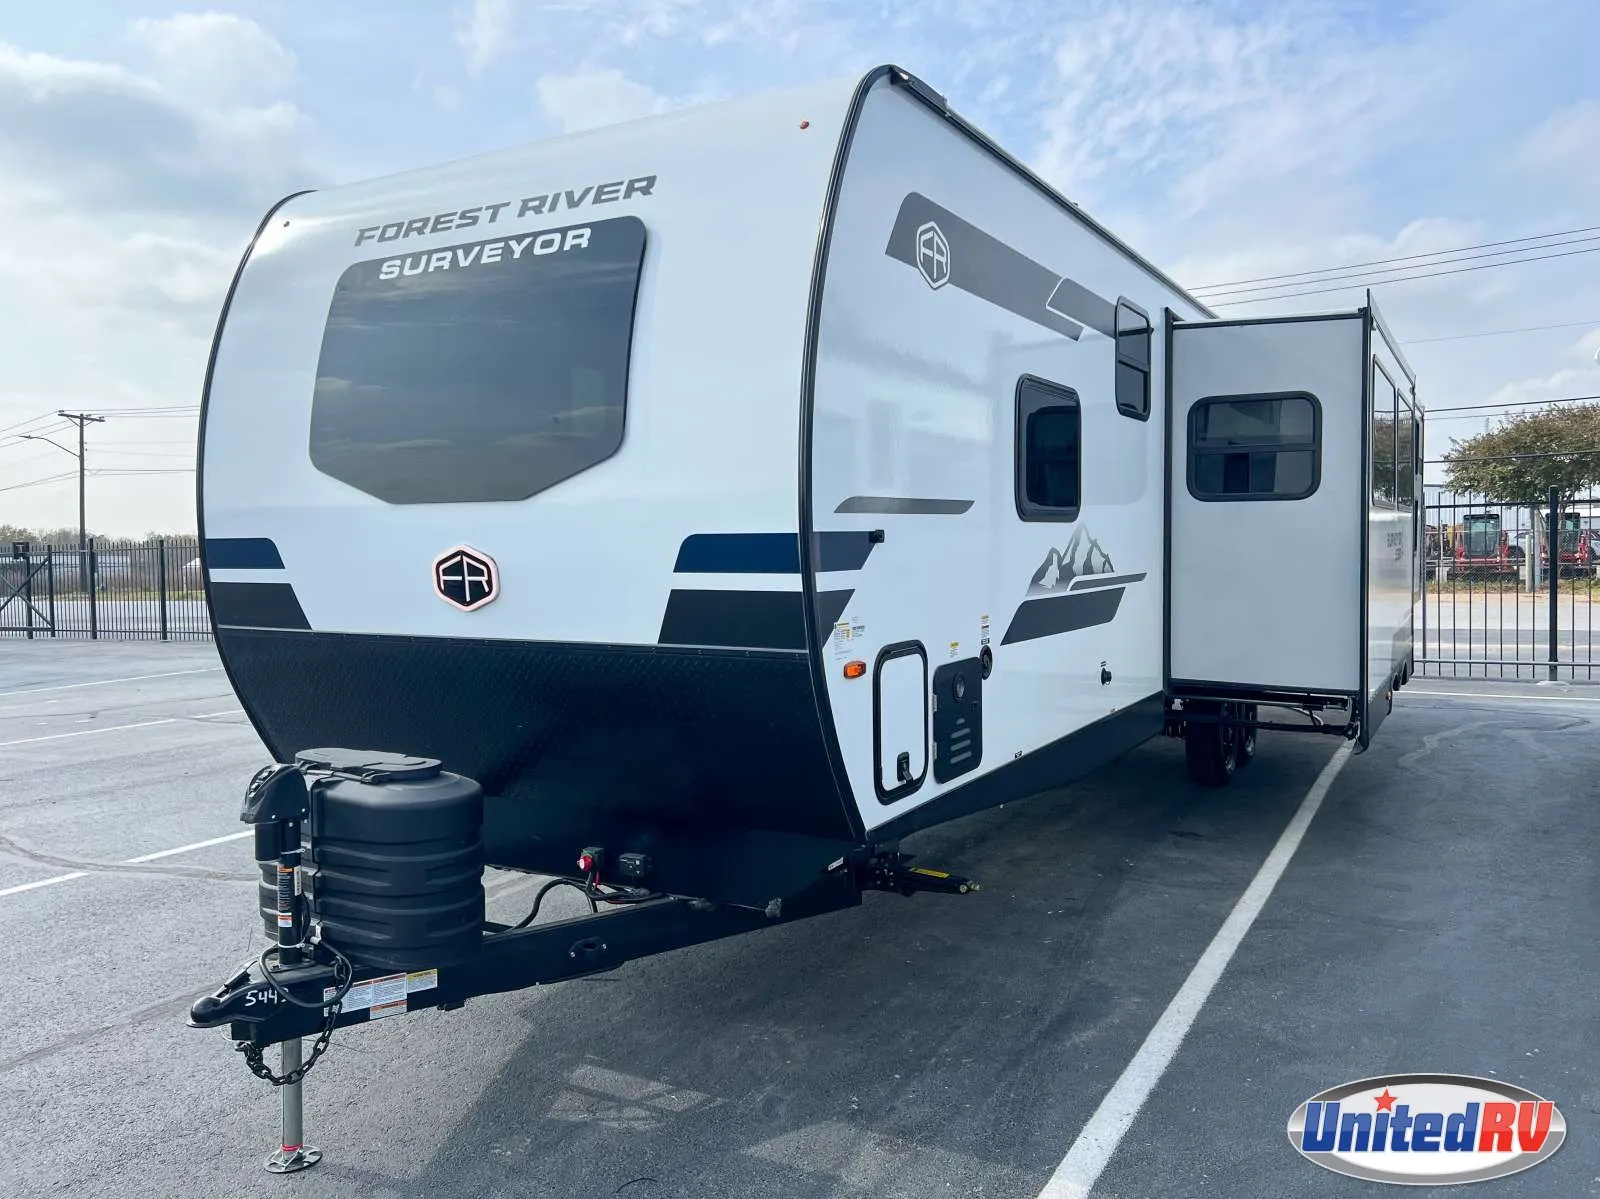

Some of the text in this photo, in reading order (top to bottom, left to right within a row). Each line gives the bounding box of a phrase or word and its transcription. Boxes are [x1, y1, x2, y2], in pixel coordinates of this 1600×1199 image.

[354, 175, 657, 247] FOREST RIVER
[378, 227, 593, 281] SURVEYOR
[438, 554, 490, 602] FR
